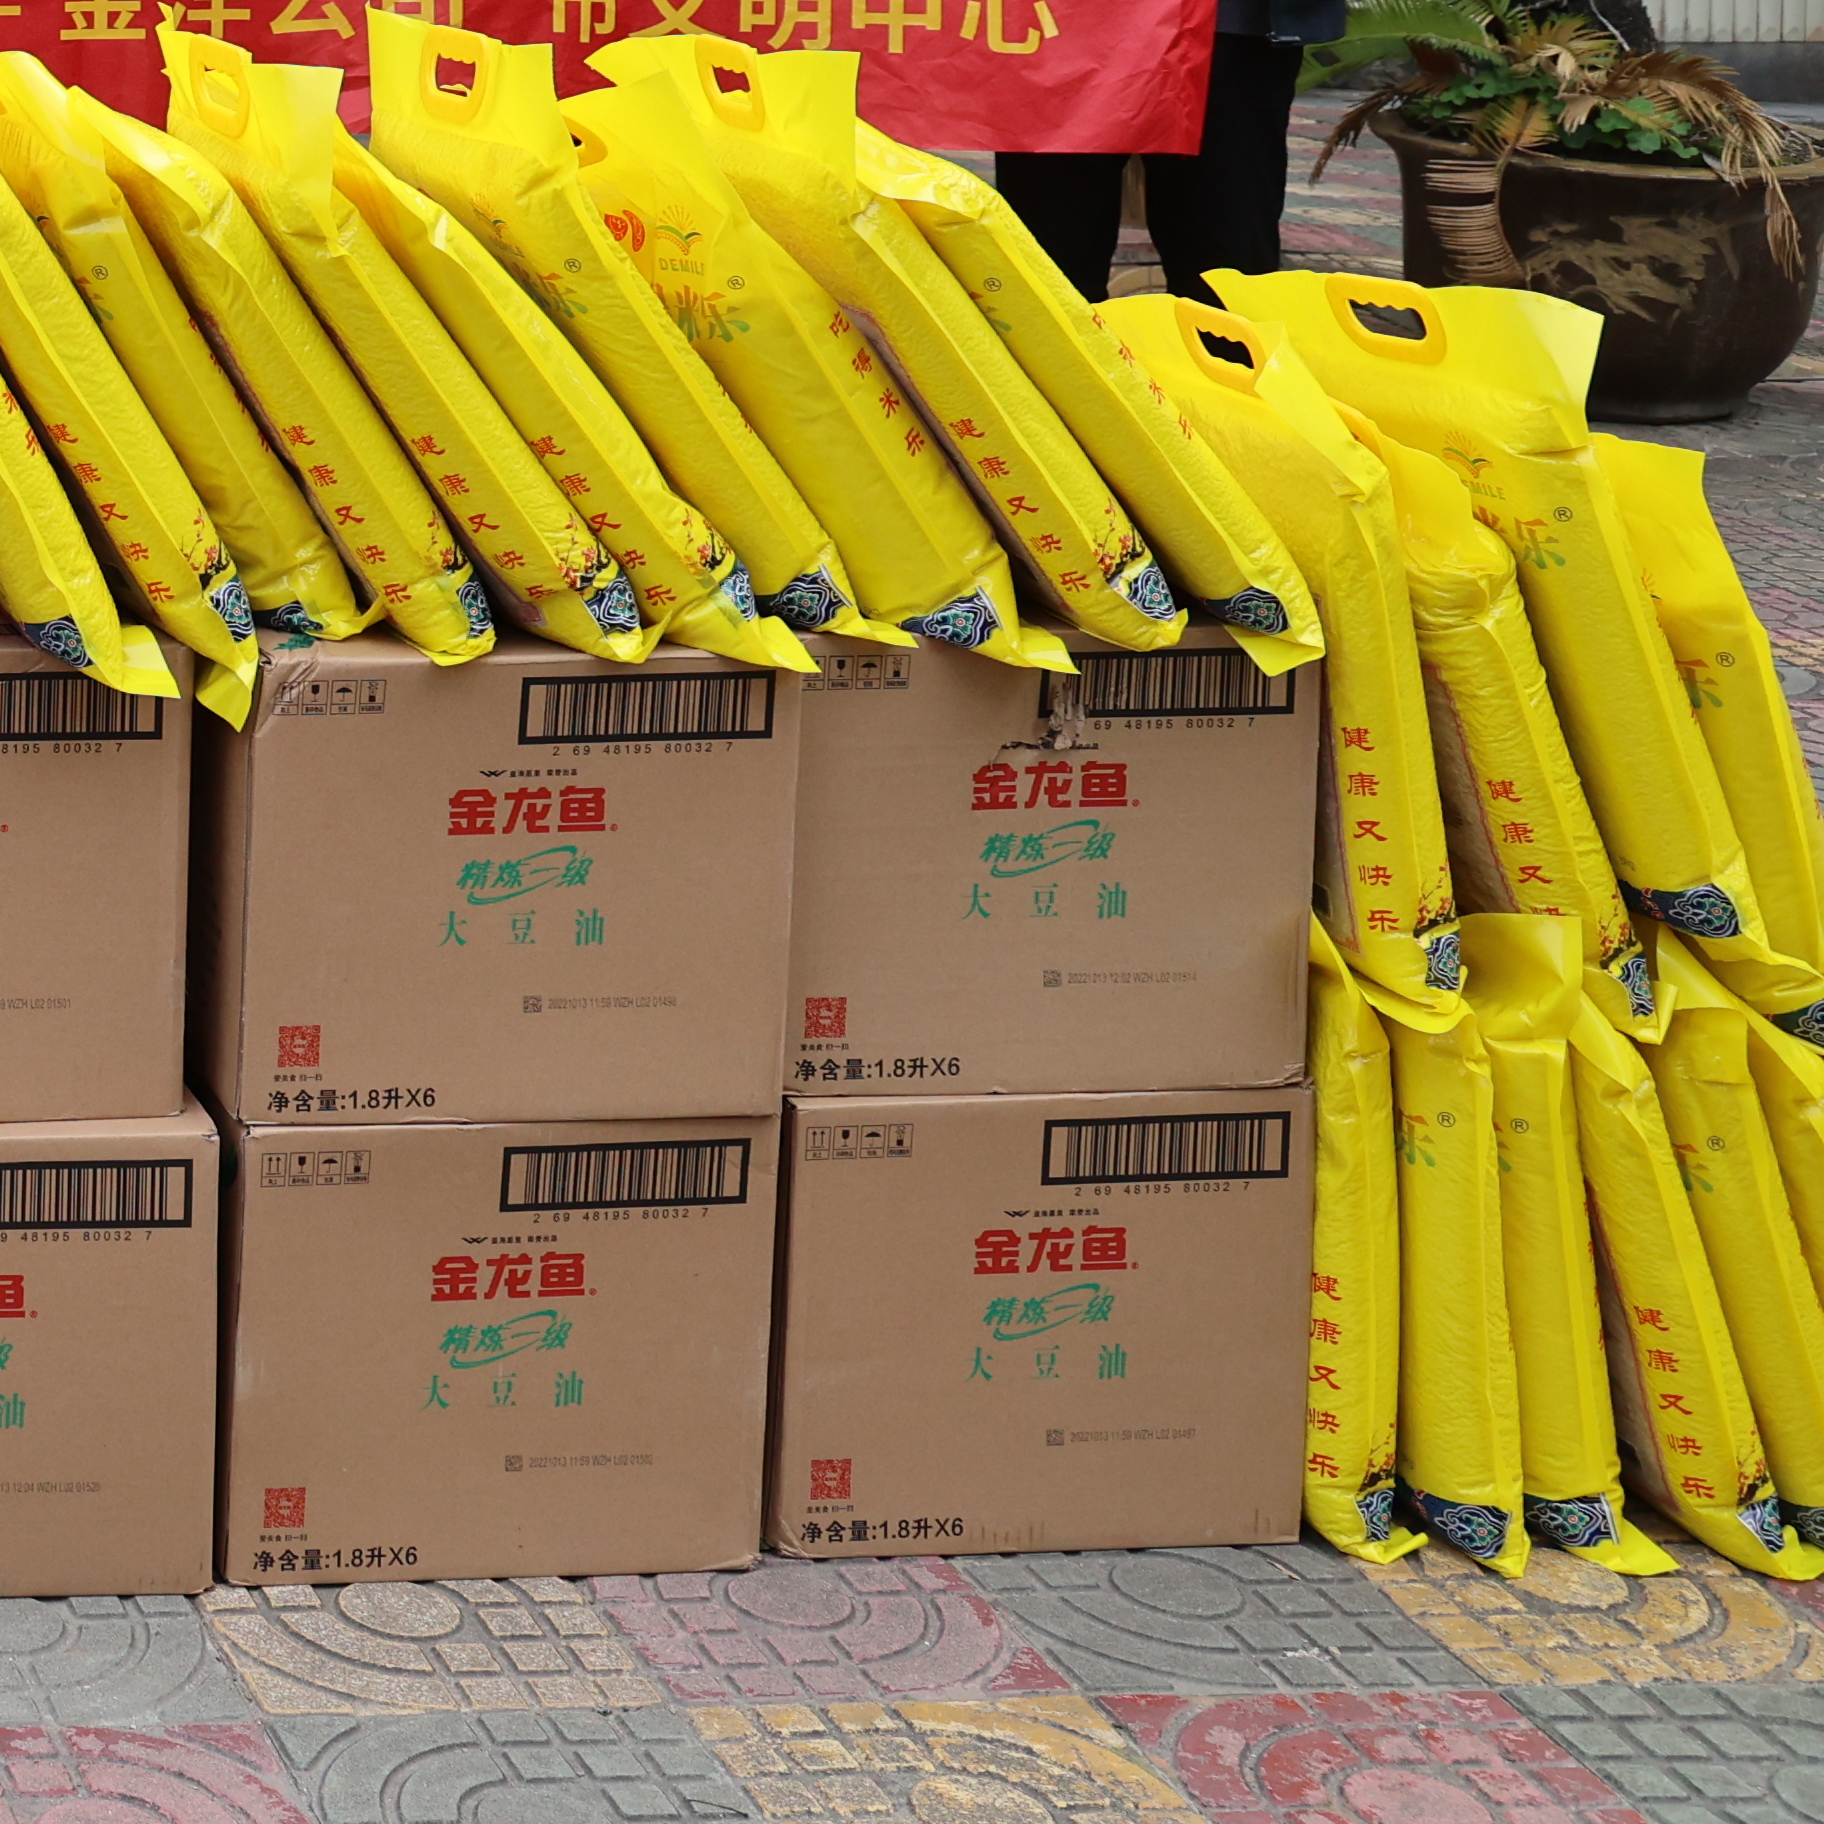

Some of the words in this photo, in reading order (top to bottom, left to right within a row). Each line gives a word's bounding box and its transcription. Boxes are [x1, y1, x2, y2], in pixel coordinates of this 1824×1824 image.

[827, 311, 926, 458] 吃得米乐
[46, 423, 175, 604] 健康又快乐
[282, 424, 412, 605] 健康又快乐
[409, 433, 555, 603] 健康又快乐
[530, 433, 677, 607] 健康又快乐
[950, 416, 1092, 592] 健康又快乐
[448, 786, 606, 836] 金龙鱼
[971, 761, 1129, 810] 金龙鱼
[980, 822, 1115, 876] 精炼一级
[1341, 726, 1400, 932] 健康又快乐
[457, 847, 593, 903] 精炼一级
[961, 883, 1128, 920] 大豆油
[437, 908, 605, 948] 大豆油
[1075, 1187, 1081, 1196] 2
[1094, 1186, 1112, 1196] 69
[1124, 1184, 1171, 1195] 48195
[1183, 1182, 1230, 1193] 80032
[1243, 1182, 1250, 1191] 7
[431, 1252, 586, 1302] 金龙鱼
[973, 1225, 1128, 1275] 金龙鱼
[439, 1312, 572, 1368] 精炼一级
[983, 1285, 1114, 1340] 精炼一级
[965, 1343, 1128, 1382] 大豆油
[1307, 1271, 1342, 1479] 健康又快乐
[420, 1371, 584, 1411] 大豆油
[1632, 1306, 1716, 1499] 健康又快乐
